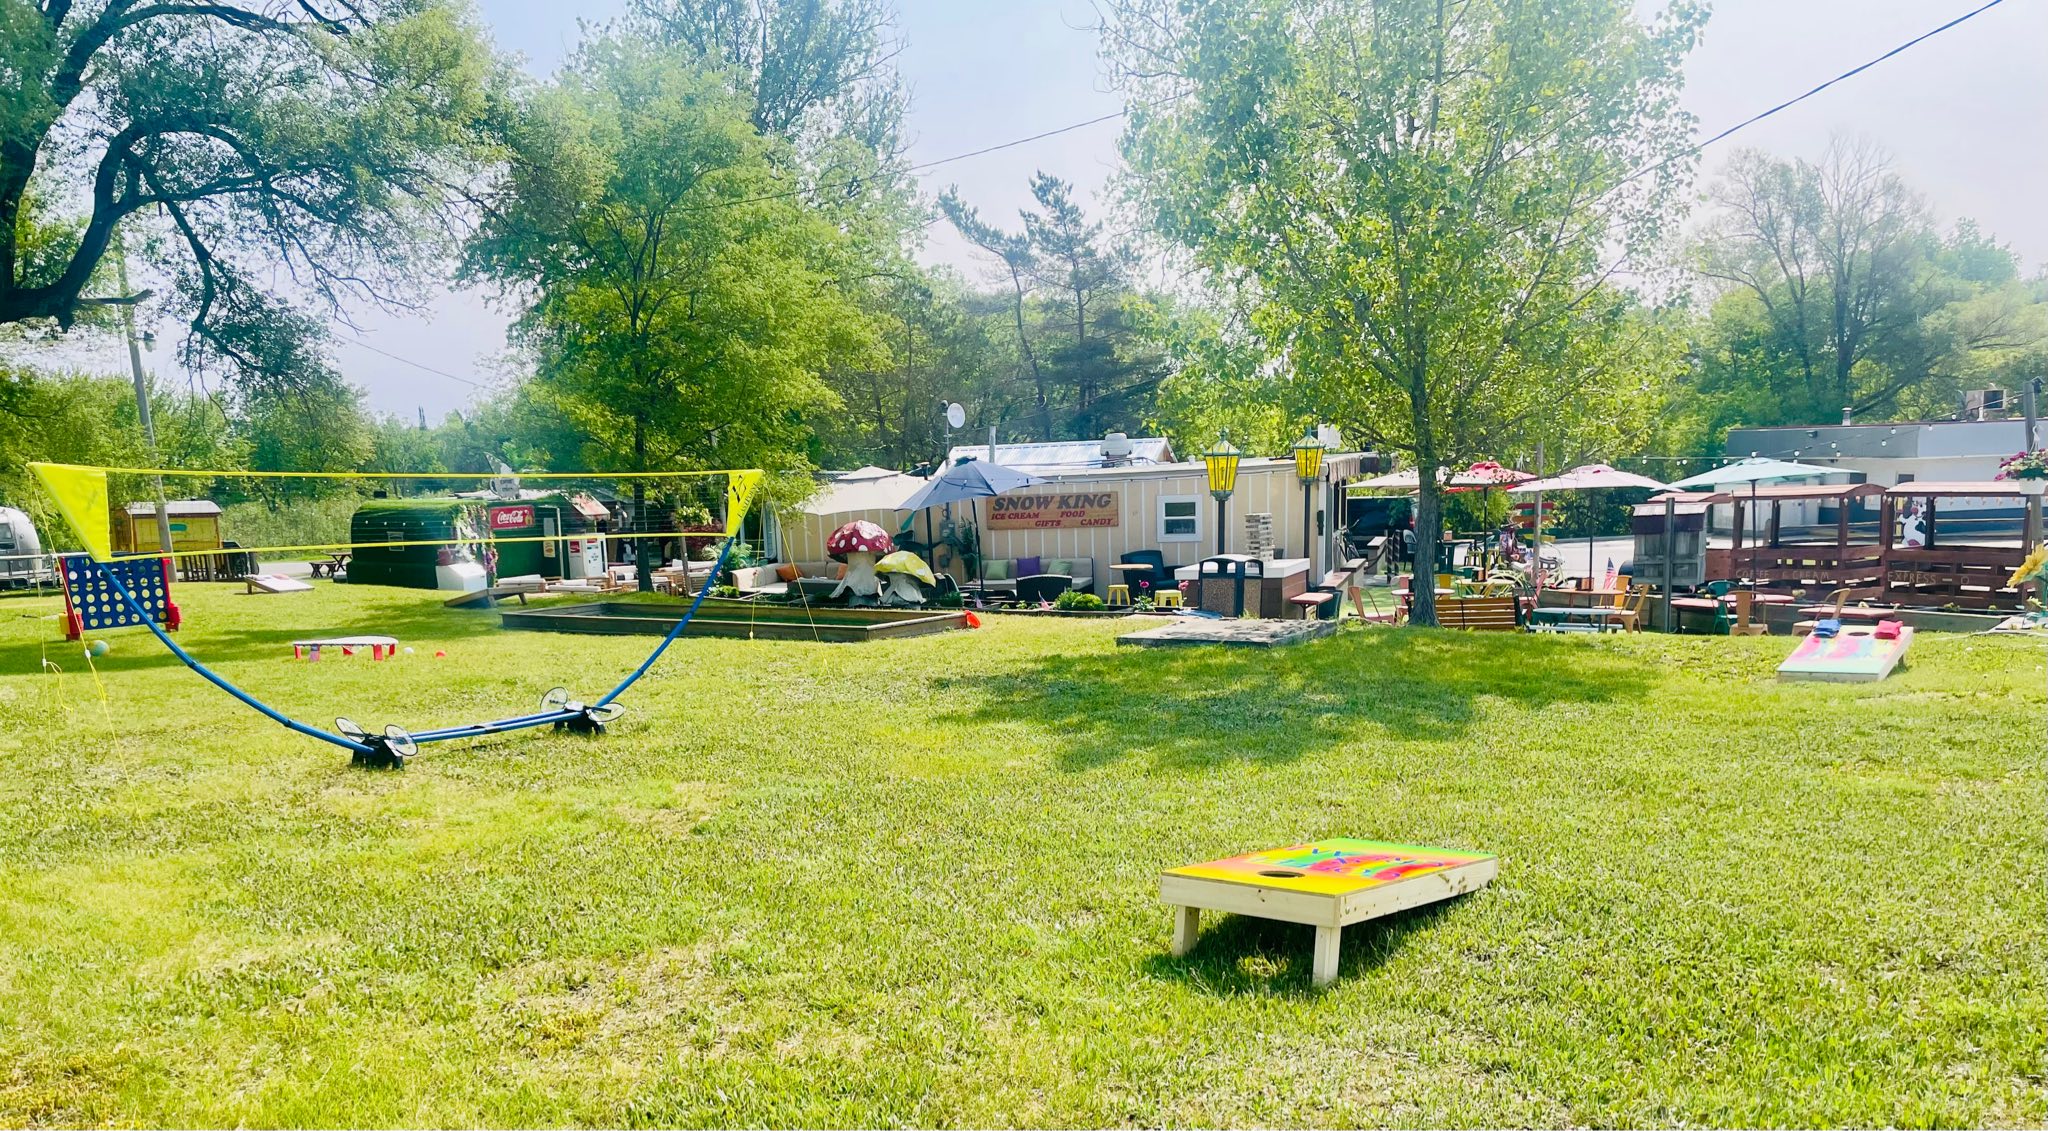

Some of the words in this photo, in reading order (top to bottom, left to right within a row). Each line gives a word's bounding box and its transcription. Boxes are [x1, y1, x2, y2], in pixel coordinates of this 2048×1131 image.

[993, 496, 1055, 511] SNOW
[1058, 493, 1111, 509] KING
[497, 510, 524, 525] Coca-Cola
[1008, 511, 1040, 520] CREAM
[1060, 510, 1085, 518] FOOD
[1081, 518, 1112, 526] CANDY
[1887, 571, 1937, 585] EXPRESS
